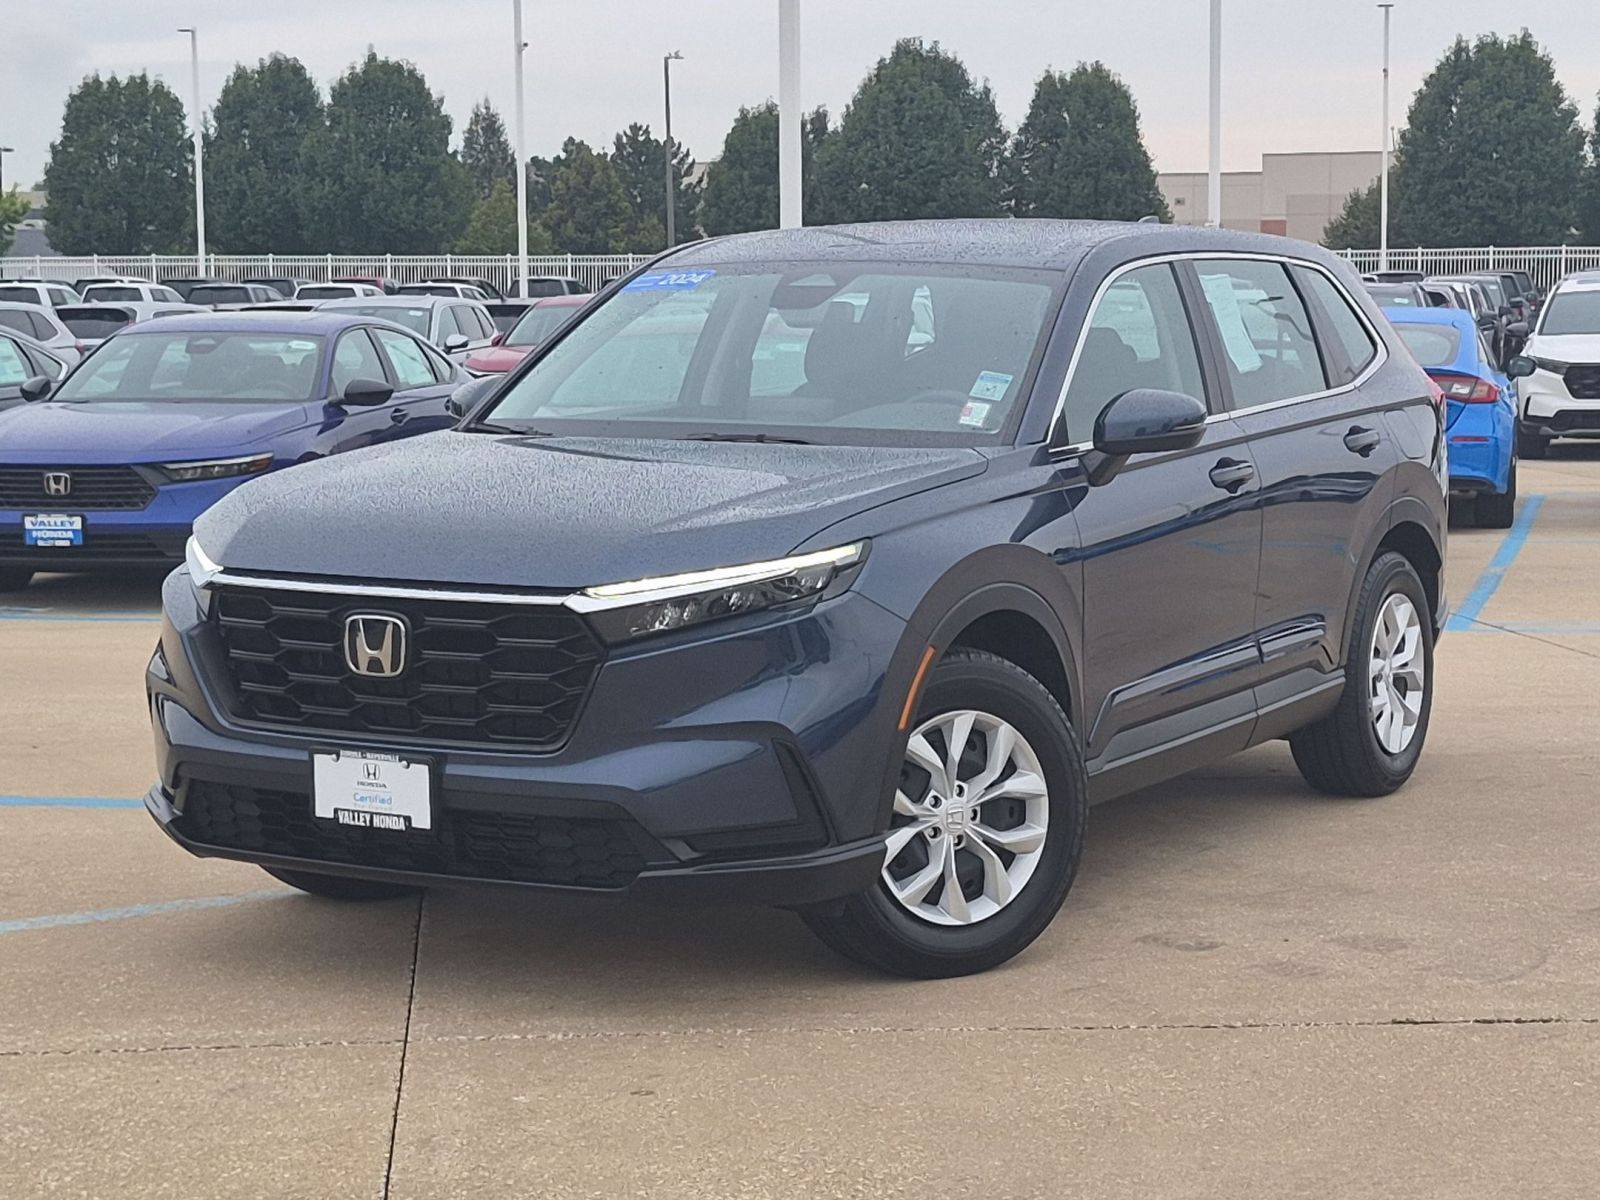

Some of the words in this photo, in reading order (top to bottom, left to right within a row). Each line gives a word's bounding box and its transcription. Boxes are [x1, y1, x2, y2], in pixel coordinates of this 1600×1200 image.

[658, 273, 707, 285] 2024
[353, 792, 393, 805] Certified
[338, 810, 371, 826] VALLEY
[373, 814, 405, 831] HONDA
